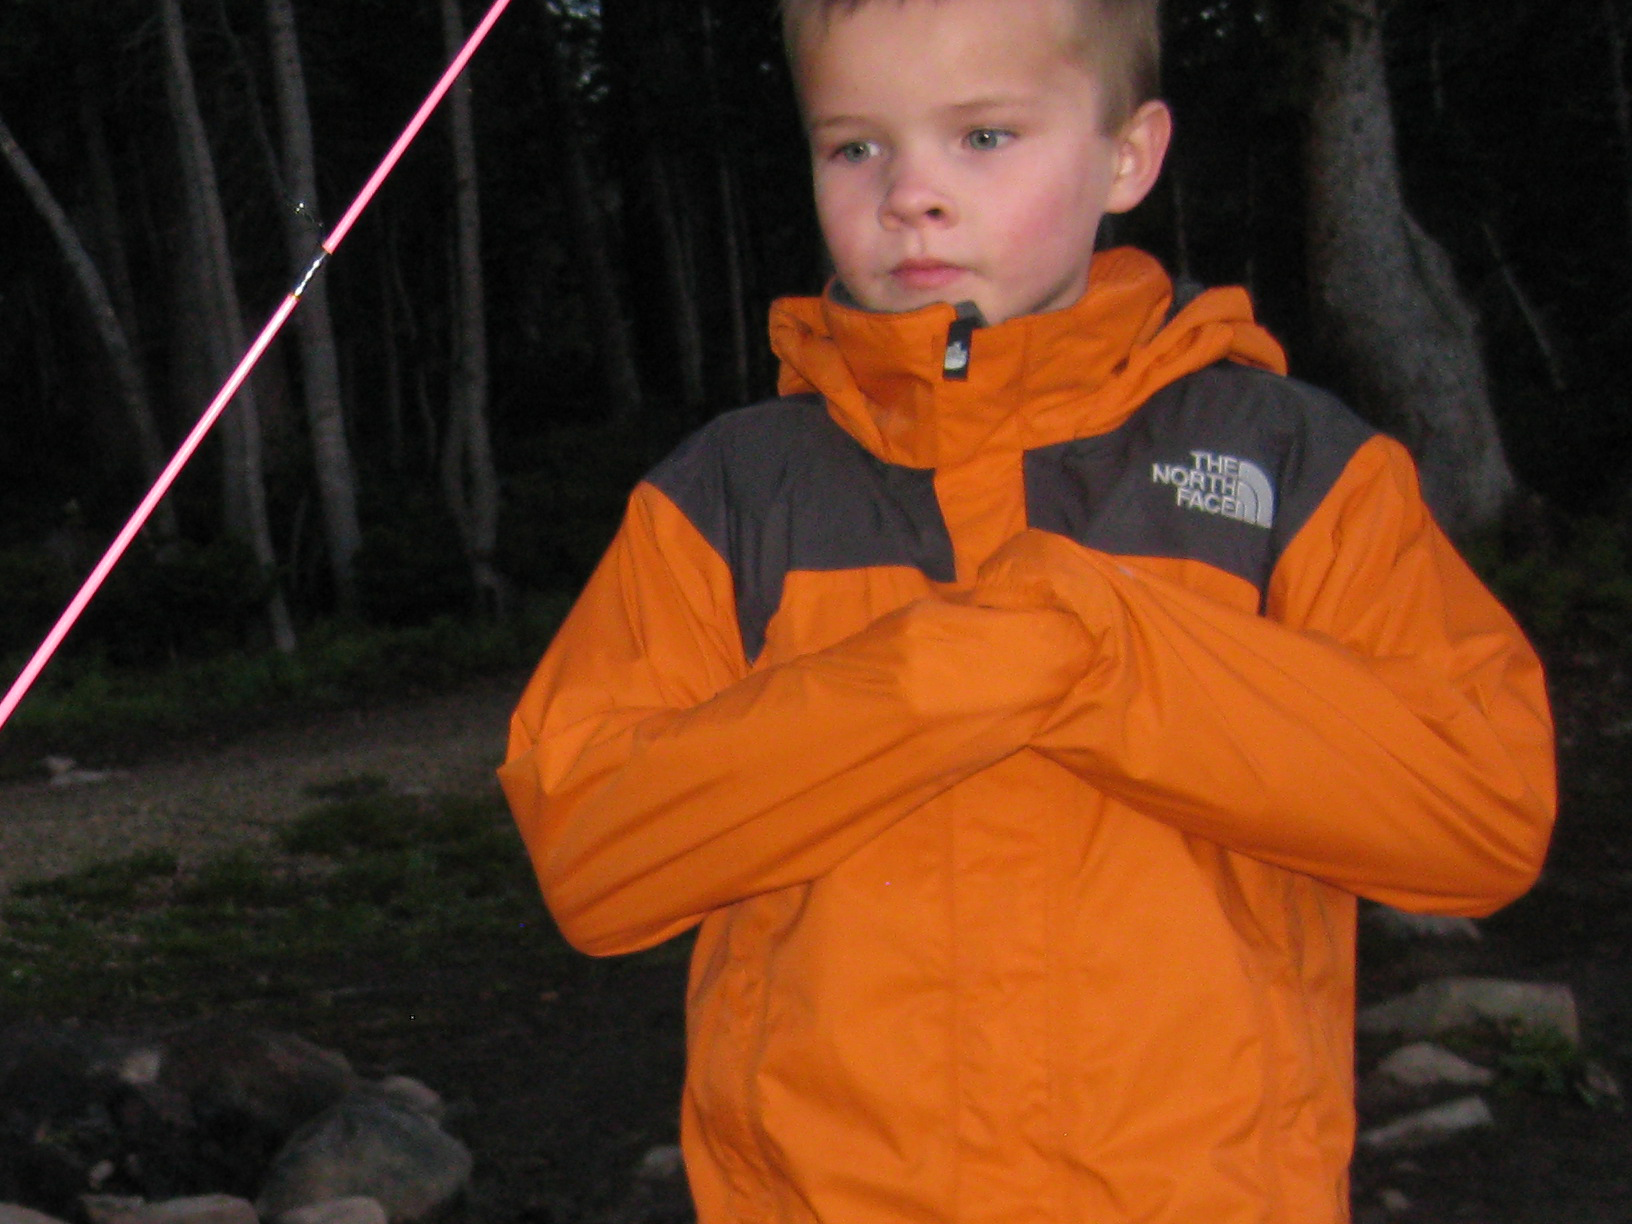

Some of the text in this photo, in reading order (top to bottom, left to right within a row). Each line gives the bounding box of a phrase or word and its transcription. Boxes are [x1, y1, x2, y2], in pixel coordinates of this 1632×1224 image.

[1190, 450, 1239, 475] THE
[1152, 462, 1237, 497] NORTH
[1176, 486, 1237, 518] FACE
